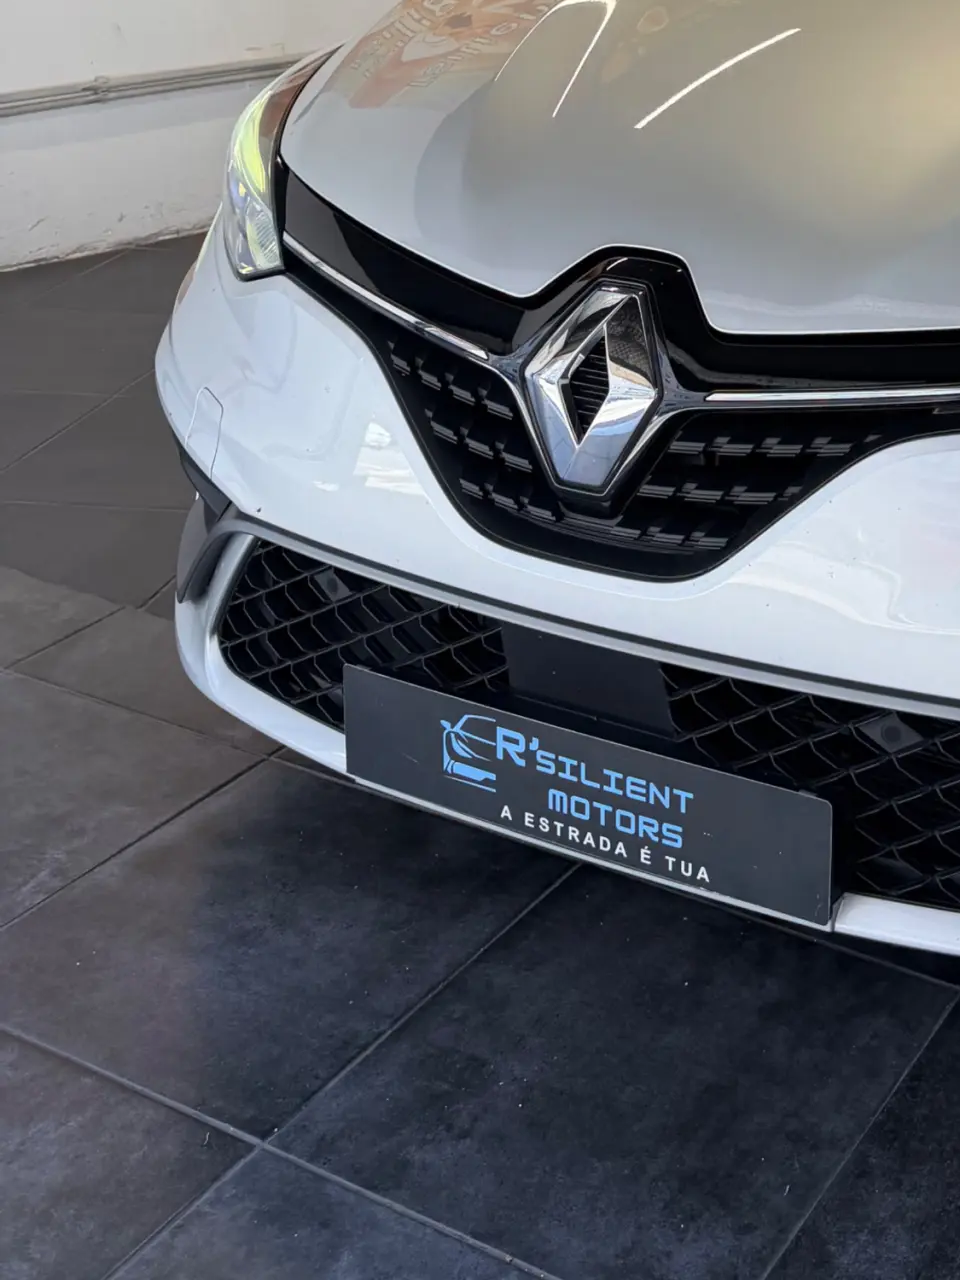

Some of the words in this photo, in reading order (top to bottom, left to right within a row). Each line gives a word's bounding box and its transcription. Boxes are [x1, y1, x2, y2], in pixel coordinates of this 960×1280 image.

[496, 725, 694, 815] R'SILIENT
[500, 804, 513, 821] A
[524, 812, 628, 858] ESTRADA
[639, 845, 652, 865] É
[665, 855, 710, 883] TUA
[548, 788, 683, 849] MOTORS
